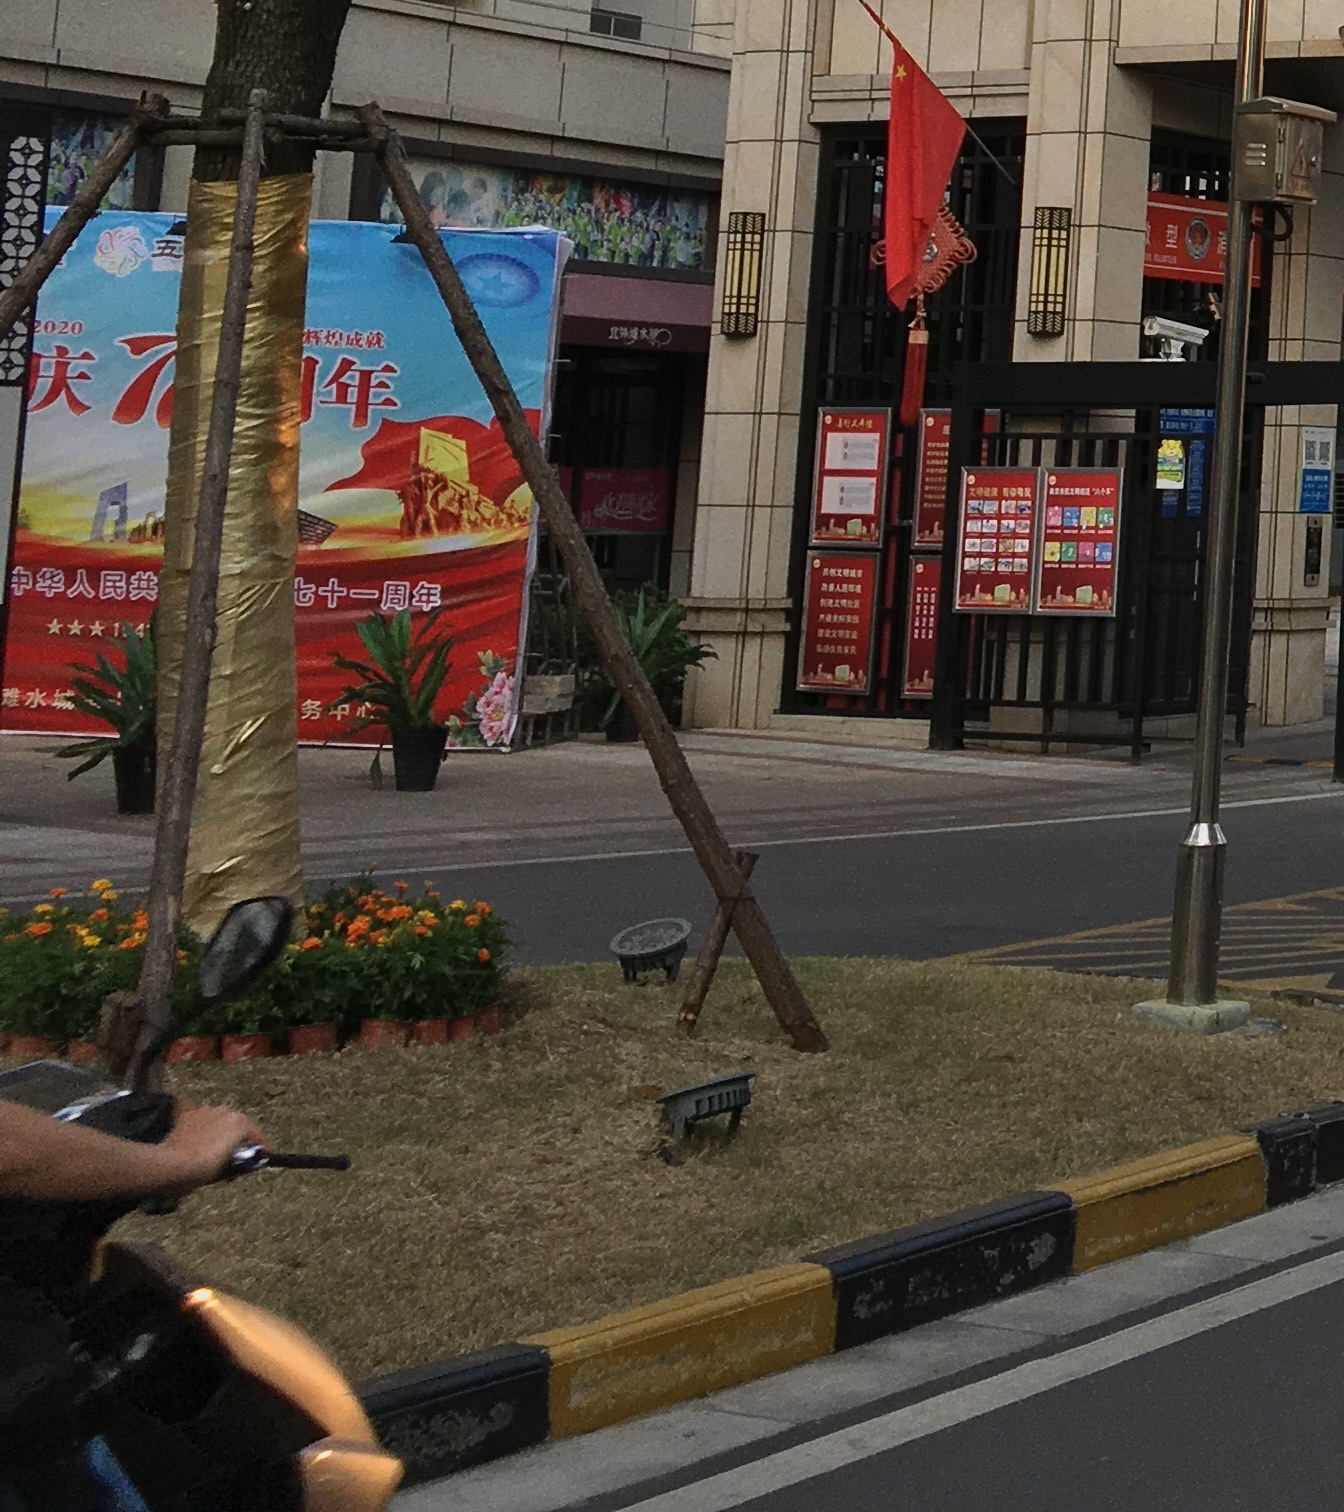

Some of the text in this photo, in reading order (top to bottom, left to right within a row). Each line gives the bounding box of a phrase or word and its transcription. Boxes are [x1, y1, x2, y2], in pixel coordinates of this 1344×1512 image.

[11, 566, 442, 612] 中华人民共 七十一周年
